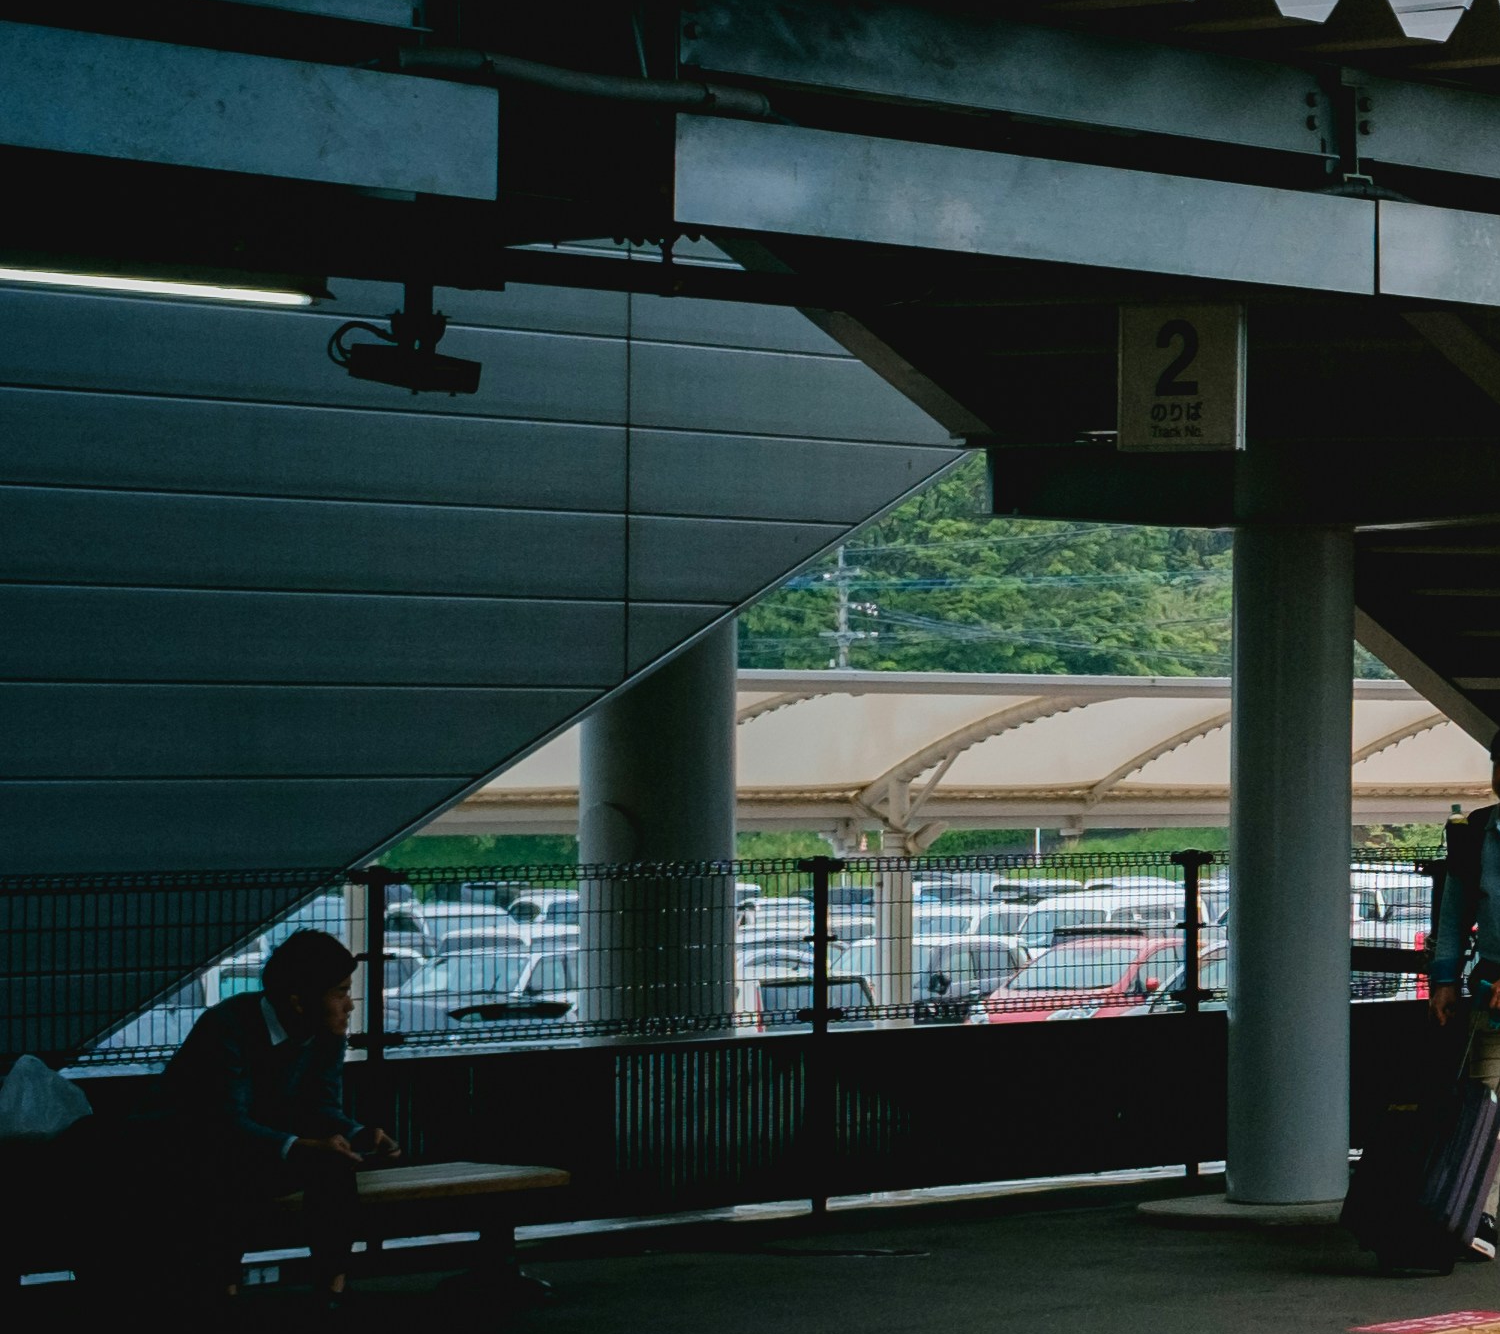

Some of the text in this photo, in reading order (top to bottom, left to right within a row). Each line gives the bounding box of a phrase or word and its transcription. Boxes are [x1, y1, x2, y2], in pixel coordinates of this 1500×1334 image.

[1155, 318, 1199, 396] 2
[1151, 401, 1203, 421] のりば
[1151, 426, 1181, 437] Track
